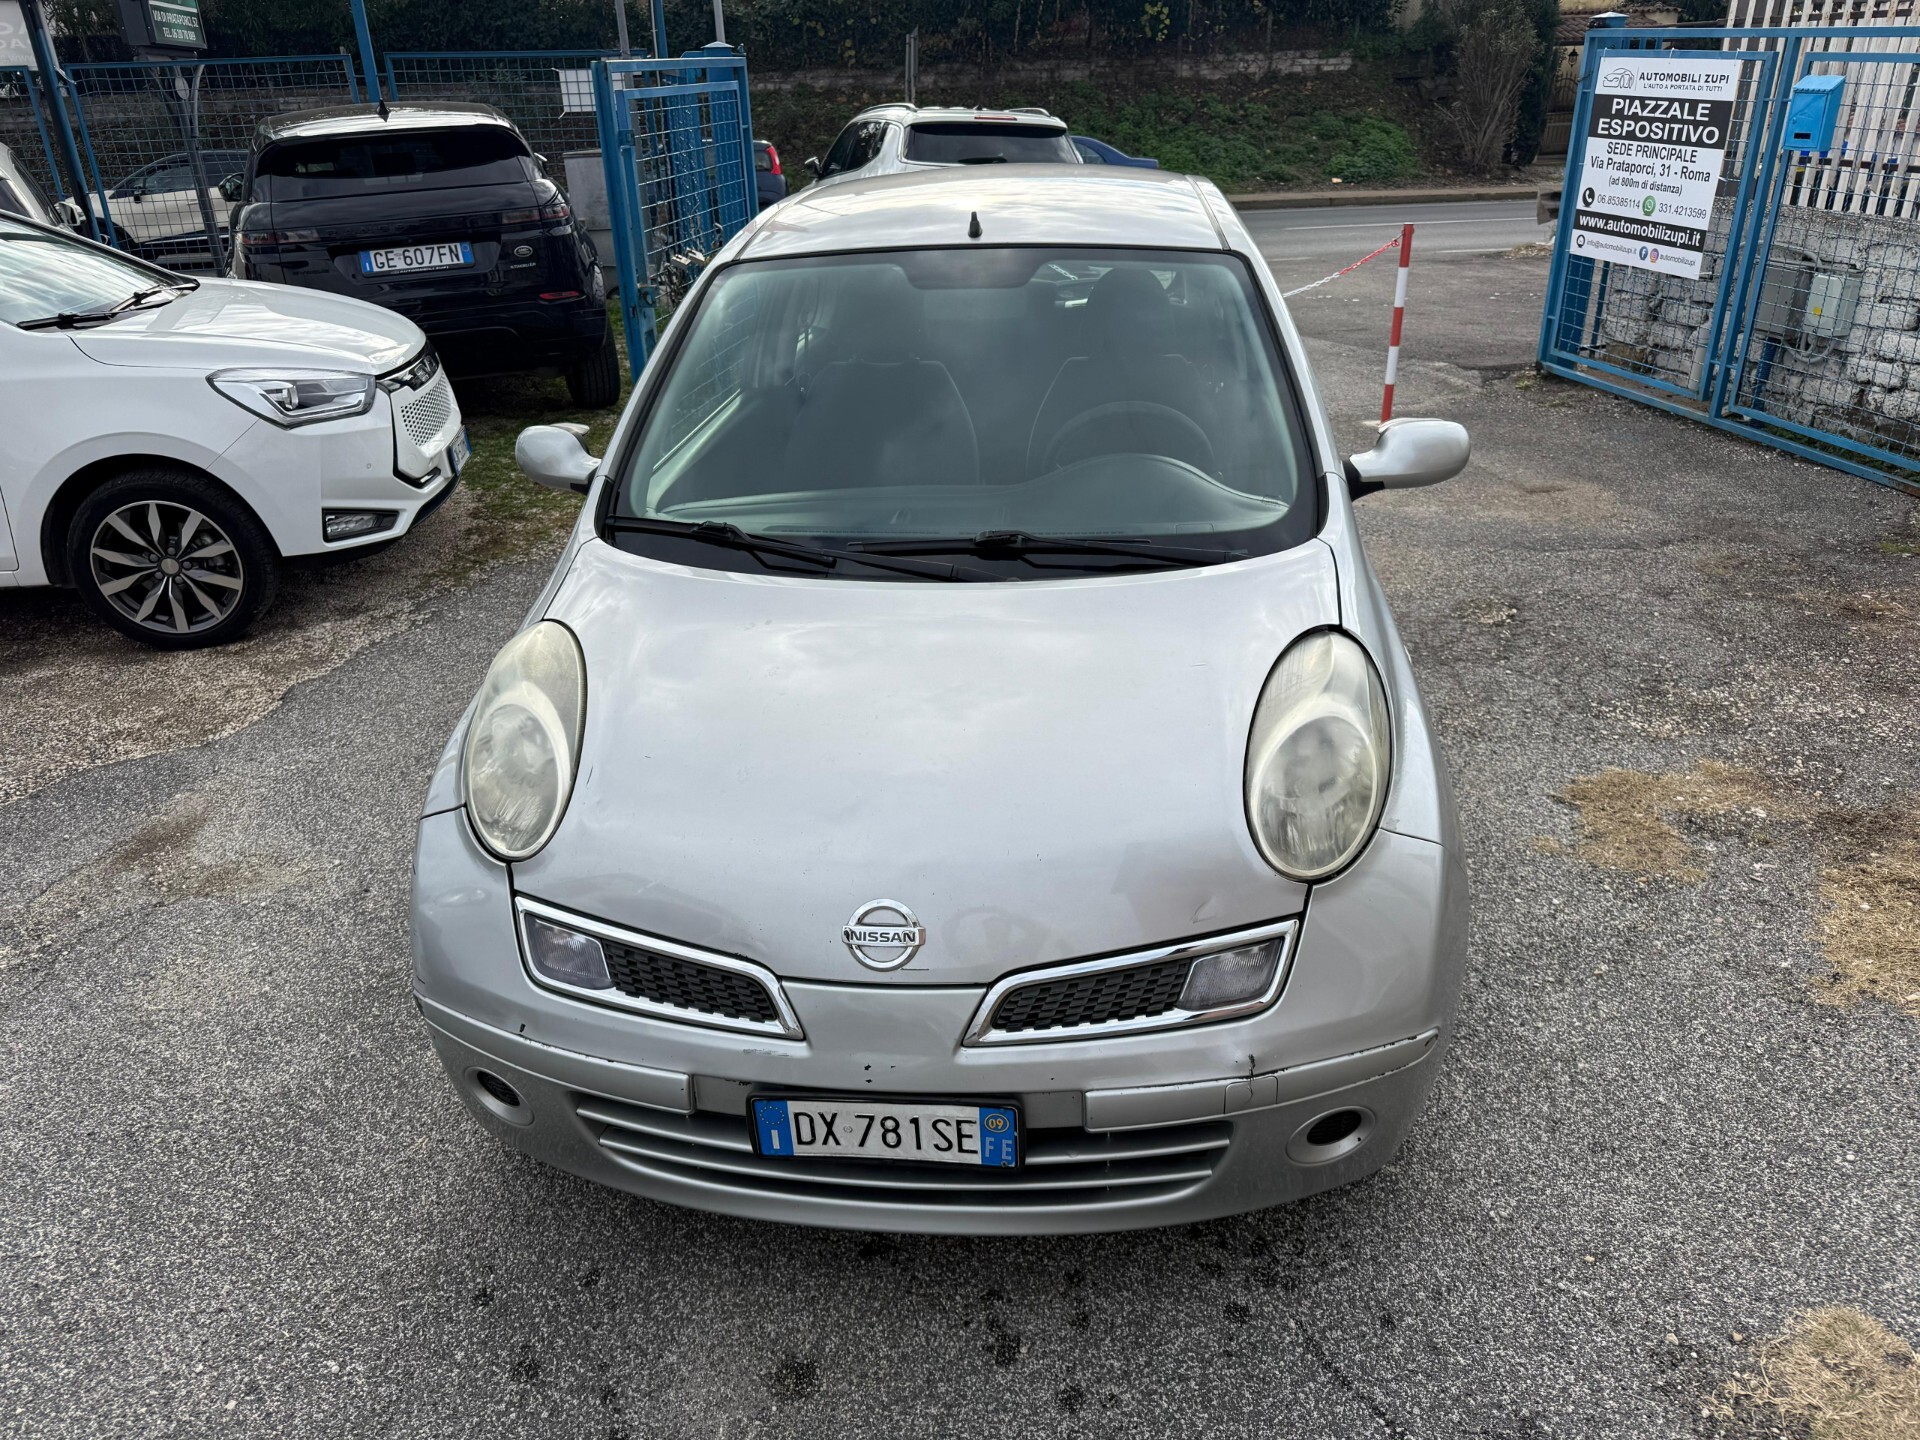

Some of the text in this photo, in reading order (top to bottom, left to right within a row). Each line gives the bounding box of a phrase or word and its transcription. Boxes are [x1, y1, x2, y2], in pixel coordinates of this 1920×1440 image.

[1639, 72, 1730, 84] AUTOMOBILI ZUPI
[1611, 98, 1712, 121] PIAZZALE
[1597, 118, 1719, 144] ESPOSITIVO
[1607, 142, 1698, 163] SEDE PRINCIPALE
[1591, 155, 1604, 169] Via
[1607, 158, 1656, 177] Prataporci,
[1659, 165, 1671, 177] 31
[1680, 166, 1711, 182] Roma
[1609, 177, 1683, 196] (ad 800m di distanza)
[1597, 194, 1707, 219] 06.85385114 331.4213599
[1580, 214, 1701, 246] www.automobilizupi.it
[374, 250, 397, 269] GE
[403, 244, 461, 266] 607FN
[1659, 253, 1695, 267] automobilizupi
[851, 931, 915, 942] NISSAN
[793, 1111, 841, 1146] DX
[855, 1114, 978, 1154] 781SE
[989, 1119, 1004, 1128] 09
